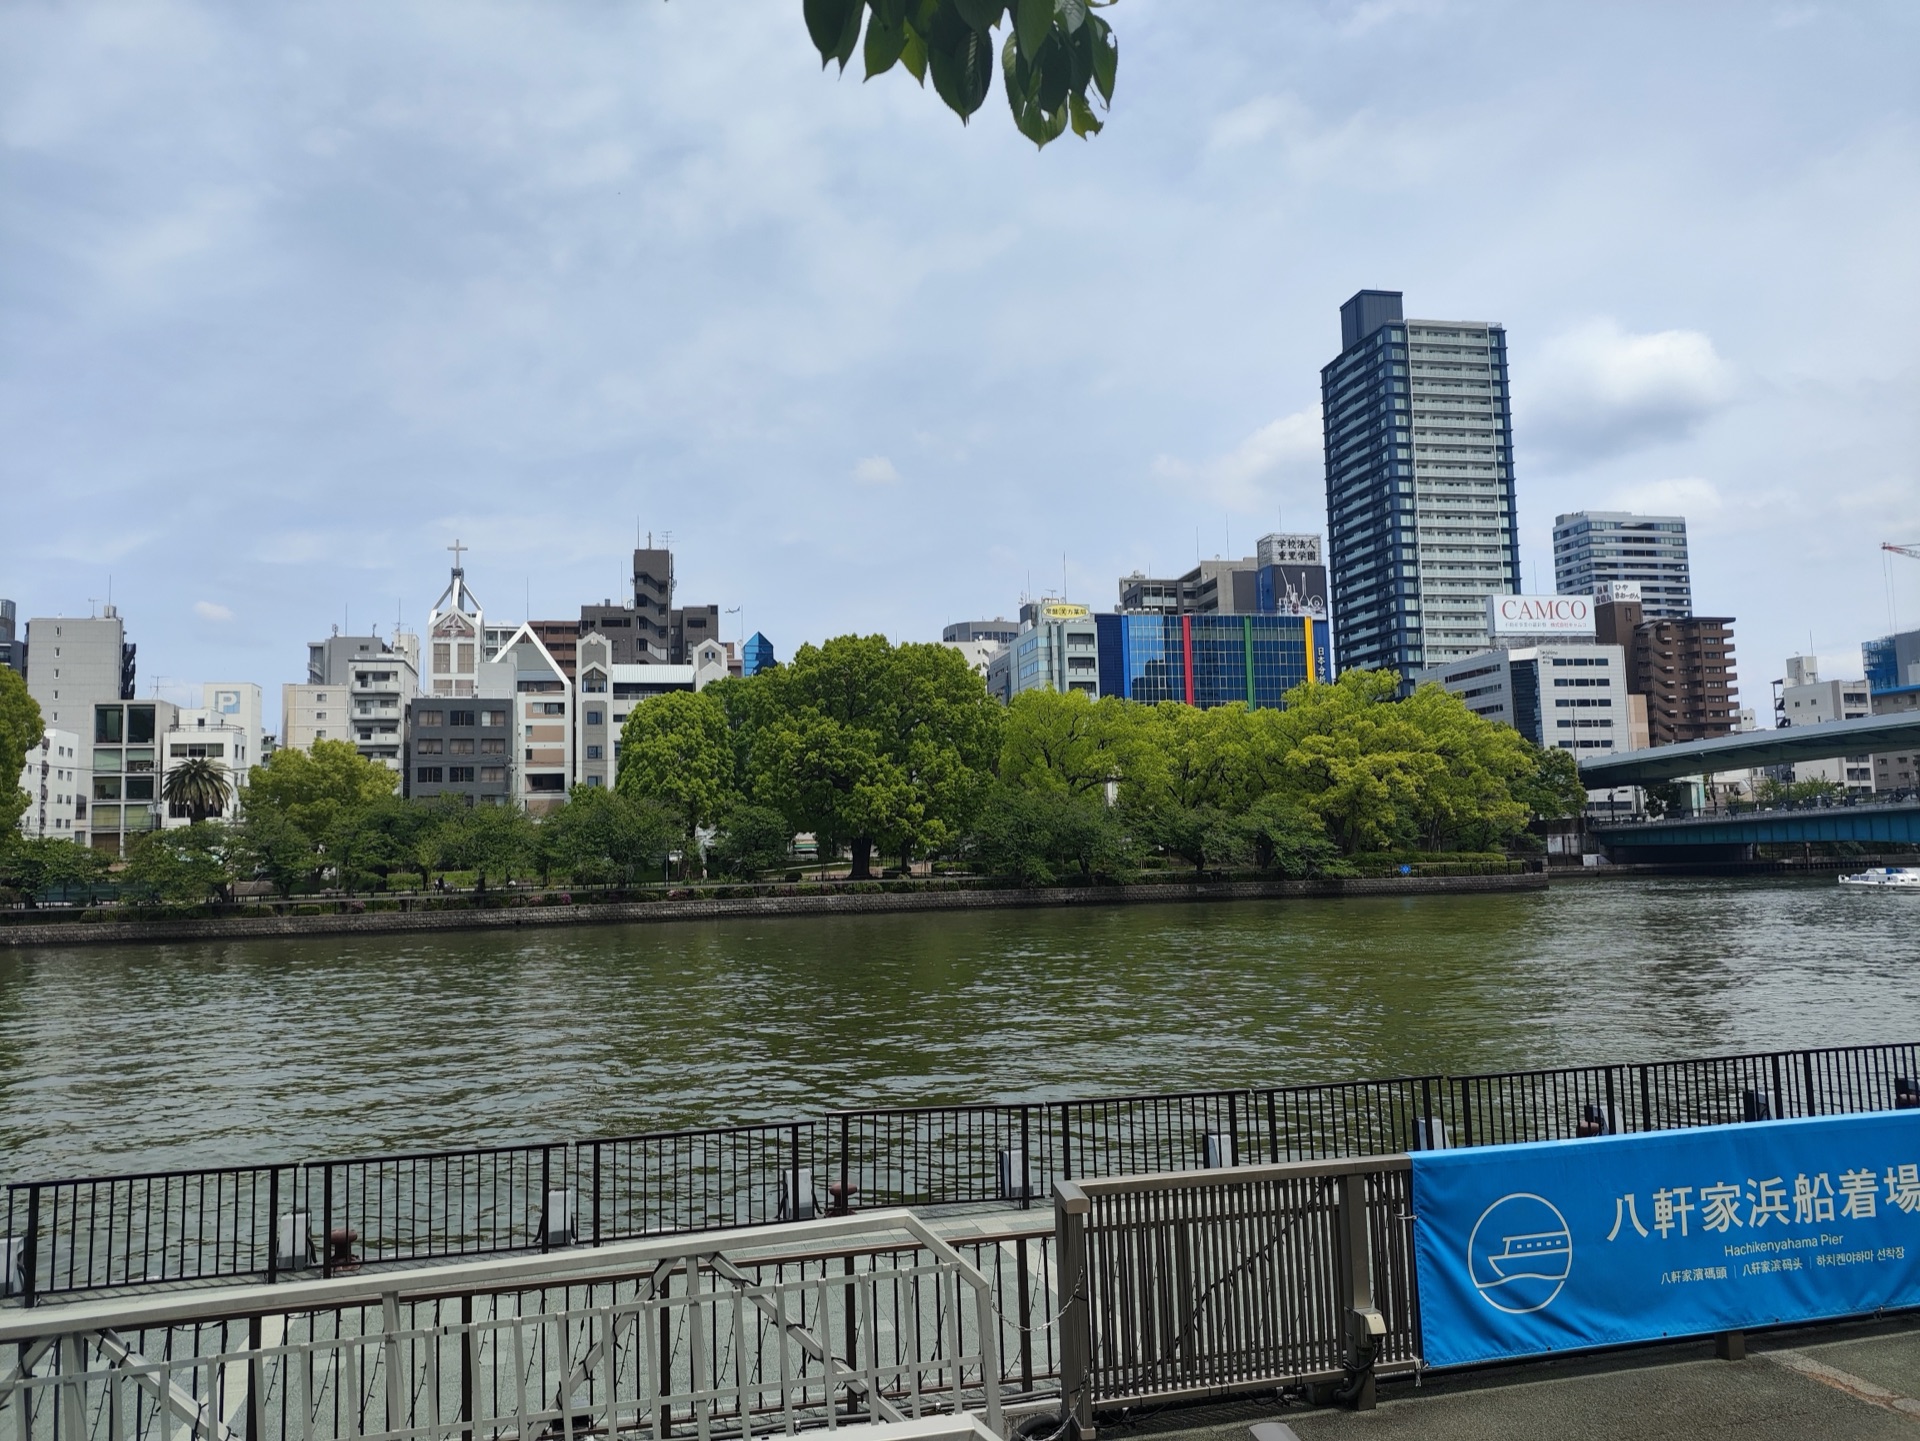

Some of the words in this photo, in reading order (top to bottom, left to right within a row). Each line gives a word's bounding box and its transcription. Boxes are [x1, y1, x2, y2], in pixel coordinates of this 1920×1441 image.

[1277, 538, 1315, 549] 学校法人
[1502, 600, 1587, 620] CAMCO
[218, 693, 237, 713] P
[1606, 1163, 1920, 1242] 八軒家浜船着場
[1724, 1238, 1818, 1257] Hachikenyahama
[1821, 1234, 1844, 1246] Pier
[1876, 1246, 1905, 1261] 선착장
